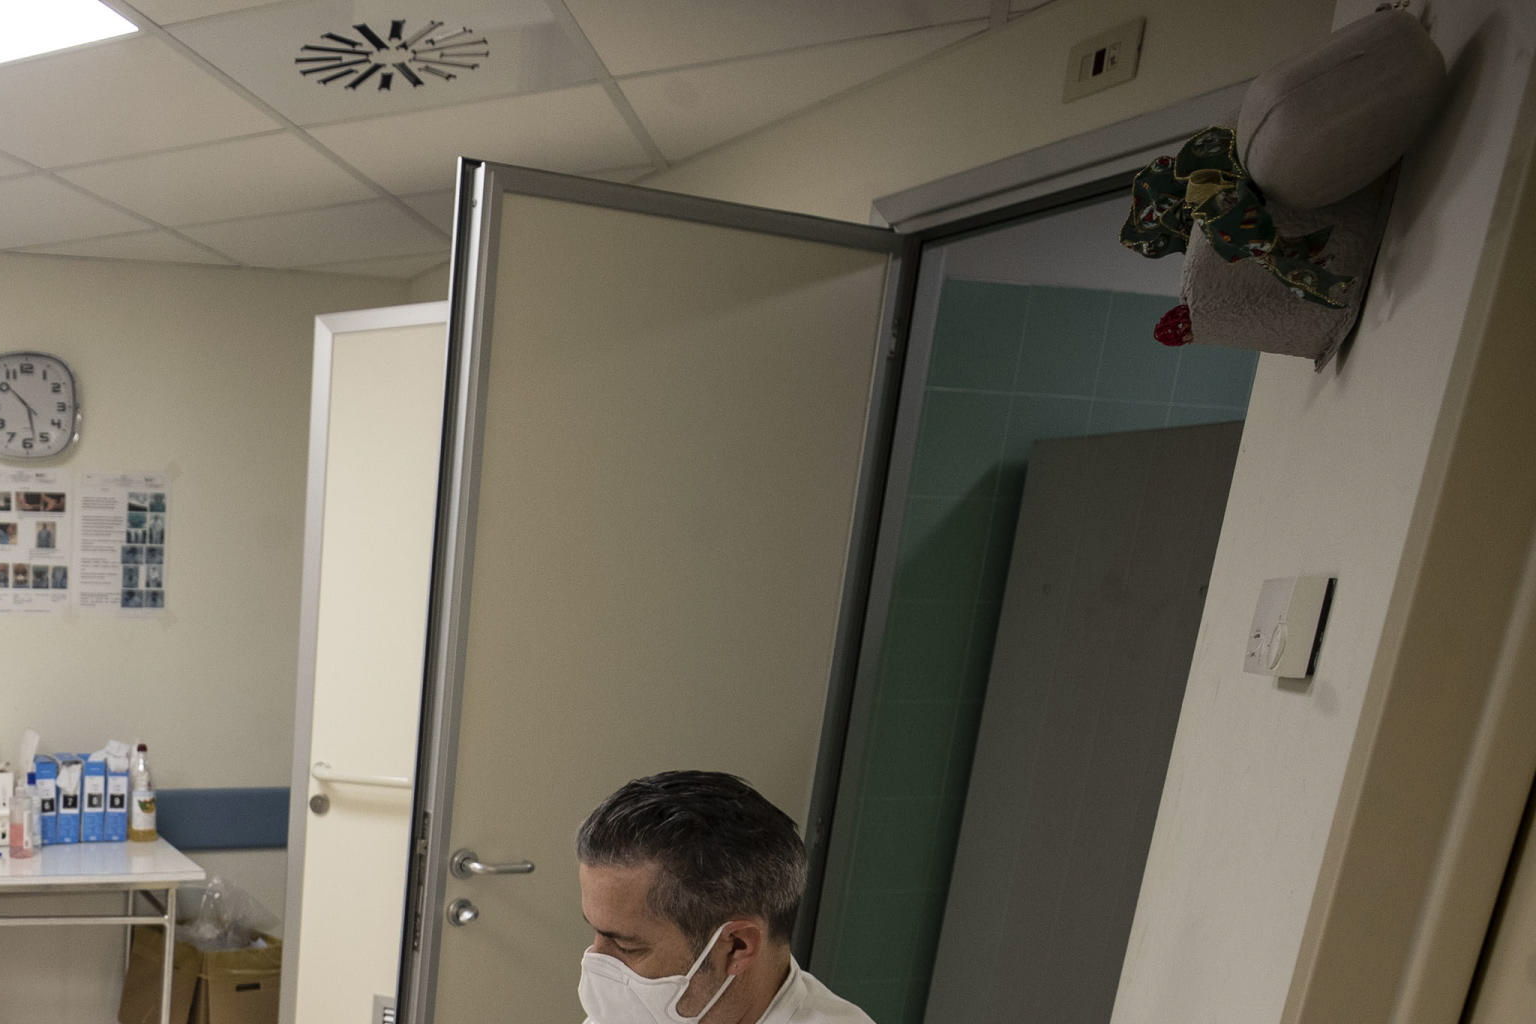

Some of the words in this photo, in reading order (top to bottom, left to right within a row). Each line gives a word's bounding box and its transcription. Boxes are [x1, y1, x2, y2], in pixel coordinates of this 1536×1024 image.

[19, 363, 34, 374] 12
[6, 369, 17, 380] 11
[51, 382, 62, 393] 2
[56, 402, 66, 412] 3
[51, 419, 62, 429] 4
[7, 432, 16, 443] 7
[39, 432, 49, 442] 5
[22, 438, 34, 449] 6
